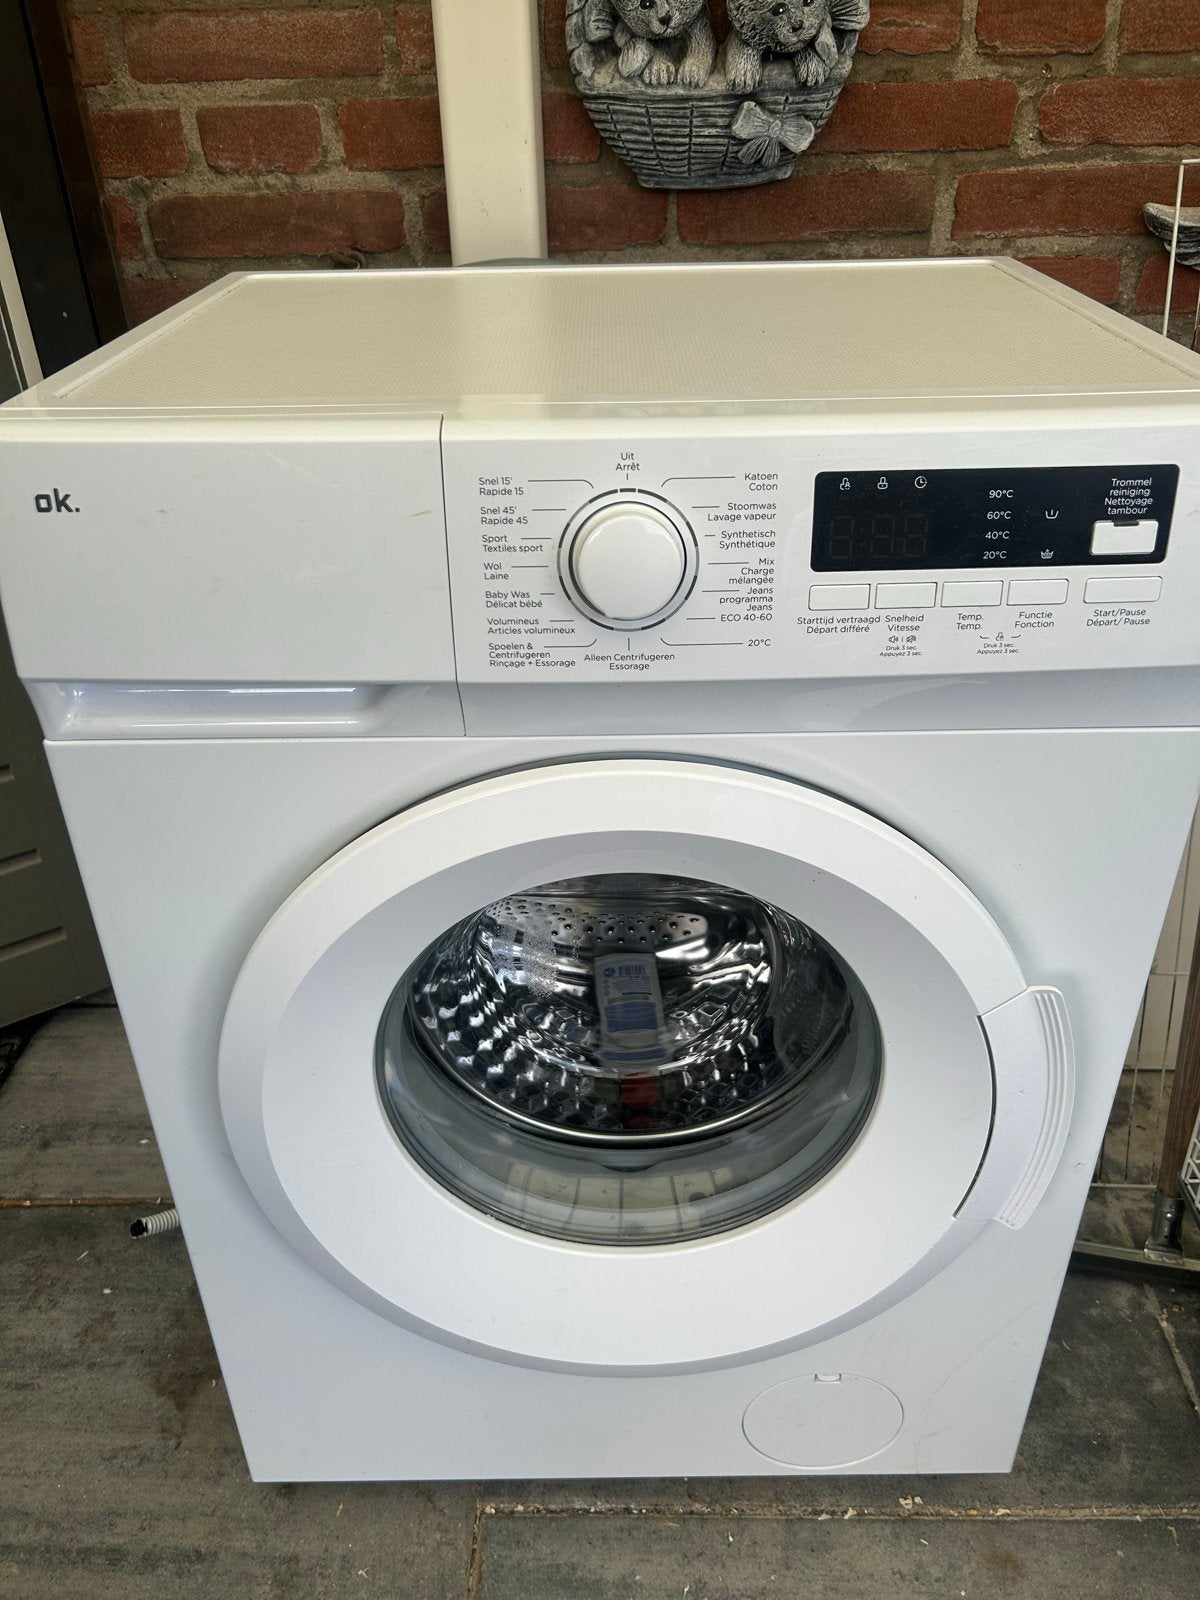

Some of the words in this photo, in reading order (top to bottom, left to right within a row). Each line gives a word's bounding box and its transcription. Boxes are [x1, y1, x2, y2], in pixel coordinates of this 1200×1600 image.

[620, 452, 634, 460] Uit
[616, 462, 642, 471] Arrêt
[479, 477, 498, 485] Snel
[501, 477, 512, 485] 15'
[1111, 478, 1152, 487] Trommel
[480, 488, 512, 496] Rapide
[989, 490, 1014, 498] 90°C
[1110, 488, 1150, 497] reiniging
[35, 488, 80, 512] ok.
[1104, 498, 1153, 506] Nettoyage
[728, 502, 776, 510] Stoomwas
[708, 514, 741, 522] Lavage
[987, 511, 1012, 520] 60°C
[481, 517, 514, 526] Rapide
[482, 535, 508, 543] Sport
[721, 530, 776, 540] Synthetisch
[985, 531, 1010, 539] 40°C
[519, 545, 544, 553] sport
[720, 540, 775, 550] Synthétique
[983, 551, 1007, 559] 20°C
[741, 567, 774, 576] Charge
[729, 576, 774, 585] mélangée
[486, 591, 508, 600] Baby
[720, 596, 773, 604] programma
[957, 613, 984, 622] Temp.
[1094, 609, 1146, 618] Start/Pause
[797, 616, 834, 625] Starttijd
[836, 615, 880, 624] vertraagd
[807, 626, 837, 635] Départ
[956, 623, 983, 631] Temp.
[488, 643, 524, 652] Spoelen
[489, 651, 550, 660] Centrifugeren
[614, 654, 675, 662] Centrifugeren
[490, 660, 526, 668] Rinçage
[536, 660, 576, 668] Essorage
